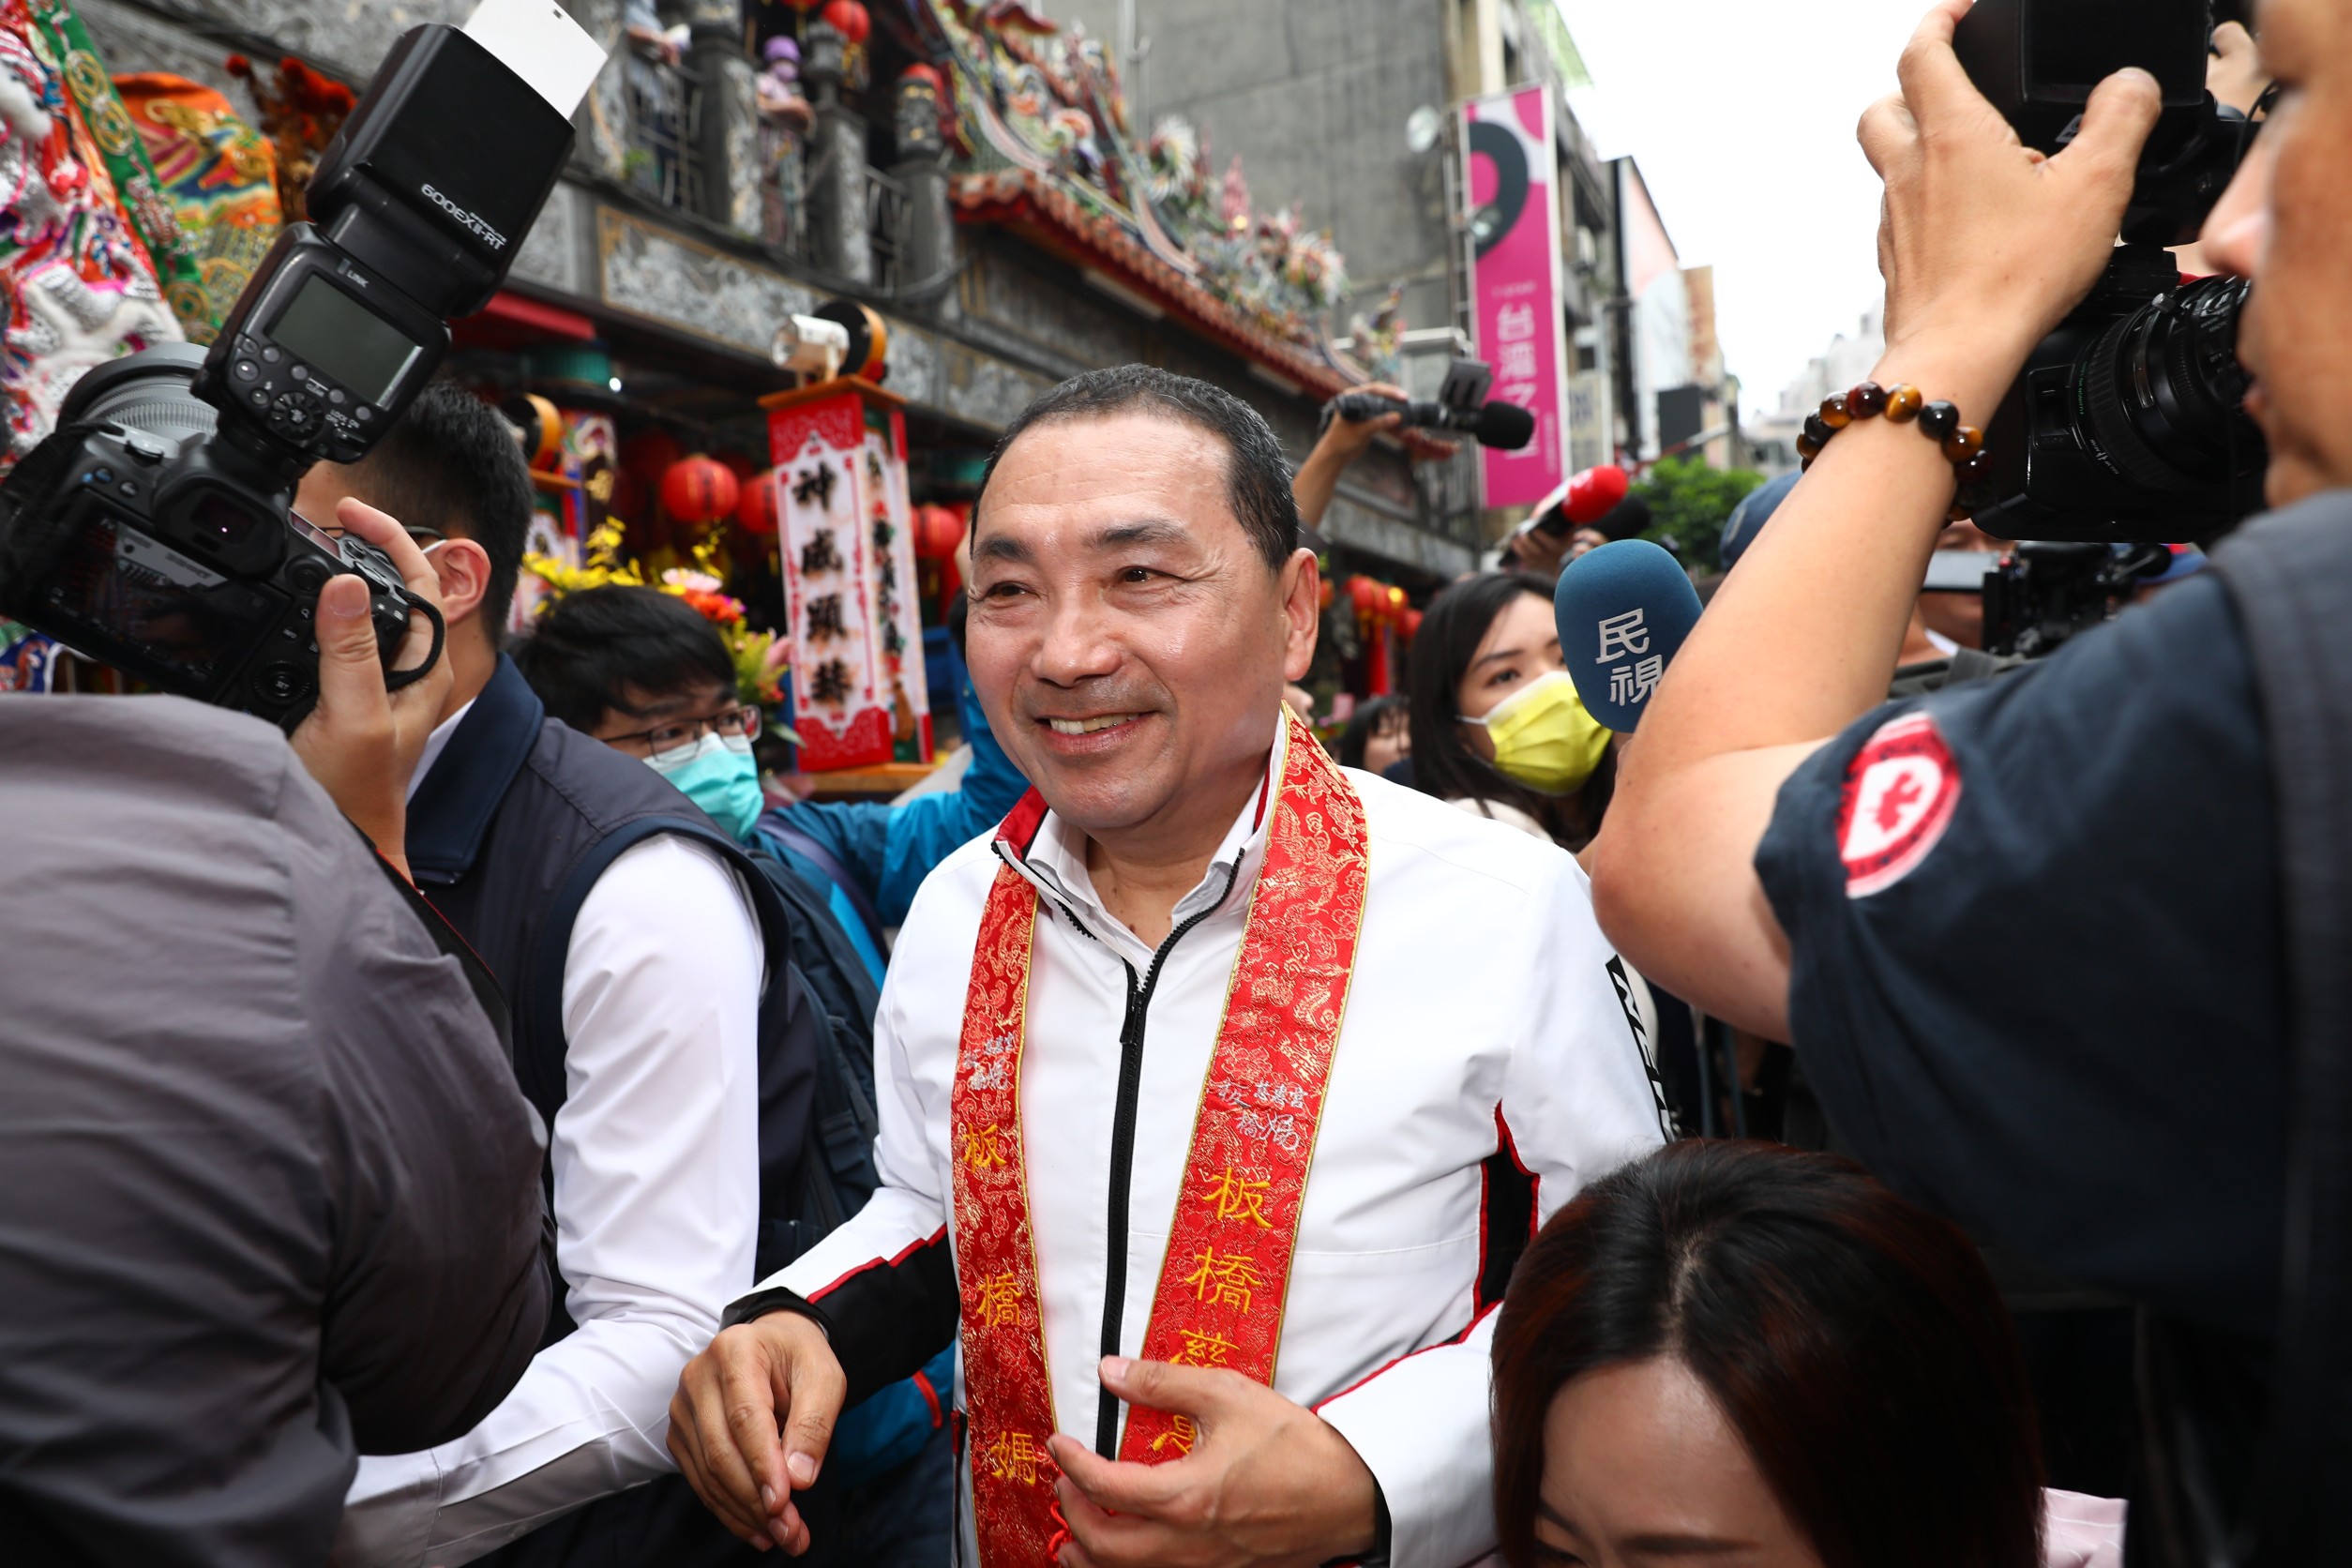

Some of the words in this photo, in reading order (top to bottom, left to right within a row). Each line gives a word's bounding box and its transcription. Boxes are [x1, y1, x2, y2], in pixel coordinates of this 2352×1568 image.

[329, 408, 348, 423] LOCK
[1595, 608, 1663, 706] 民視
[962, 1122, 1036, 1485] 板橋媽
